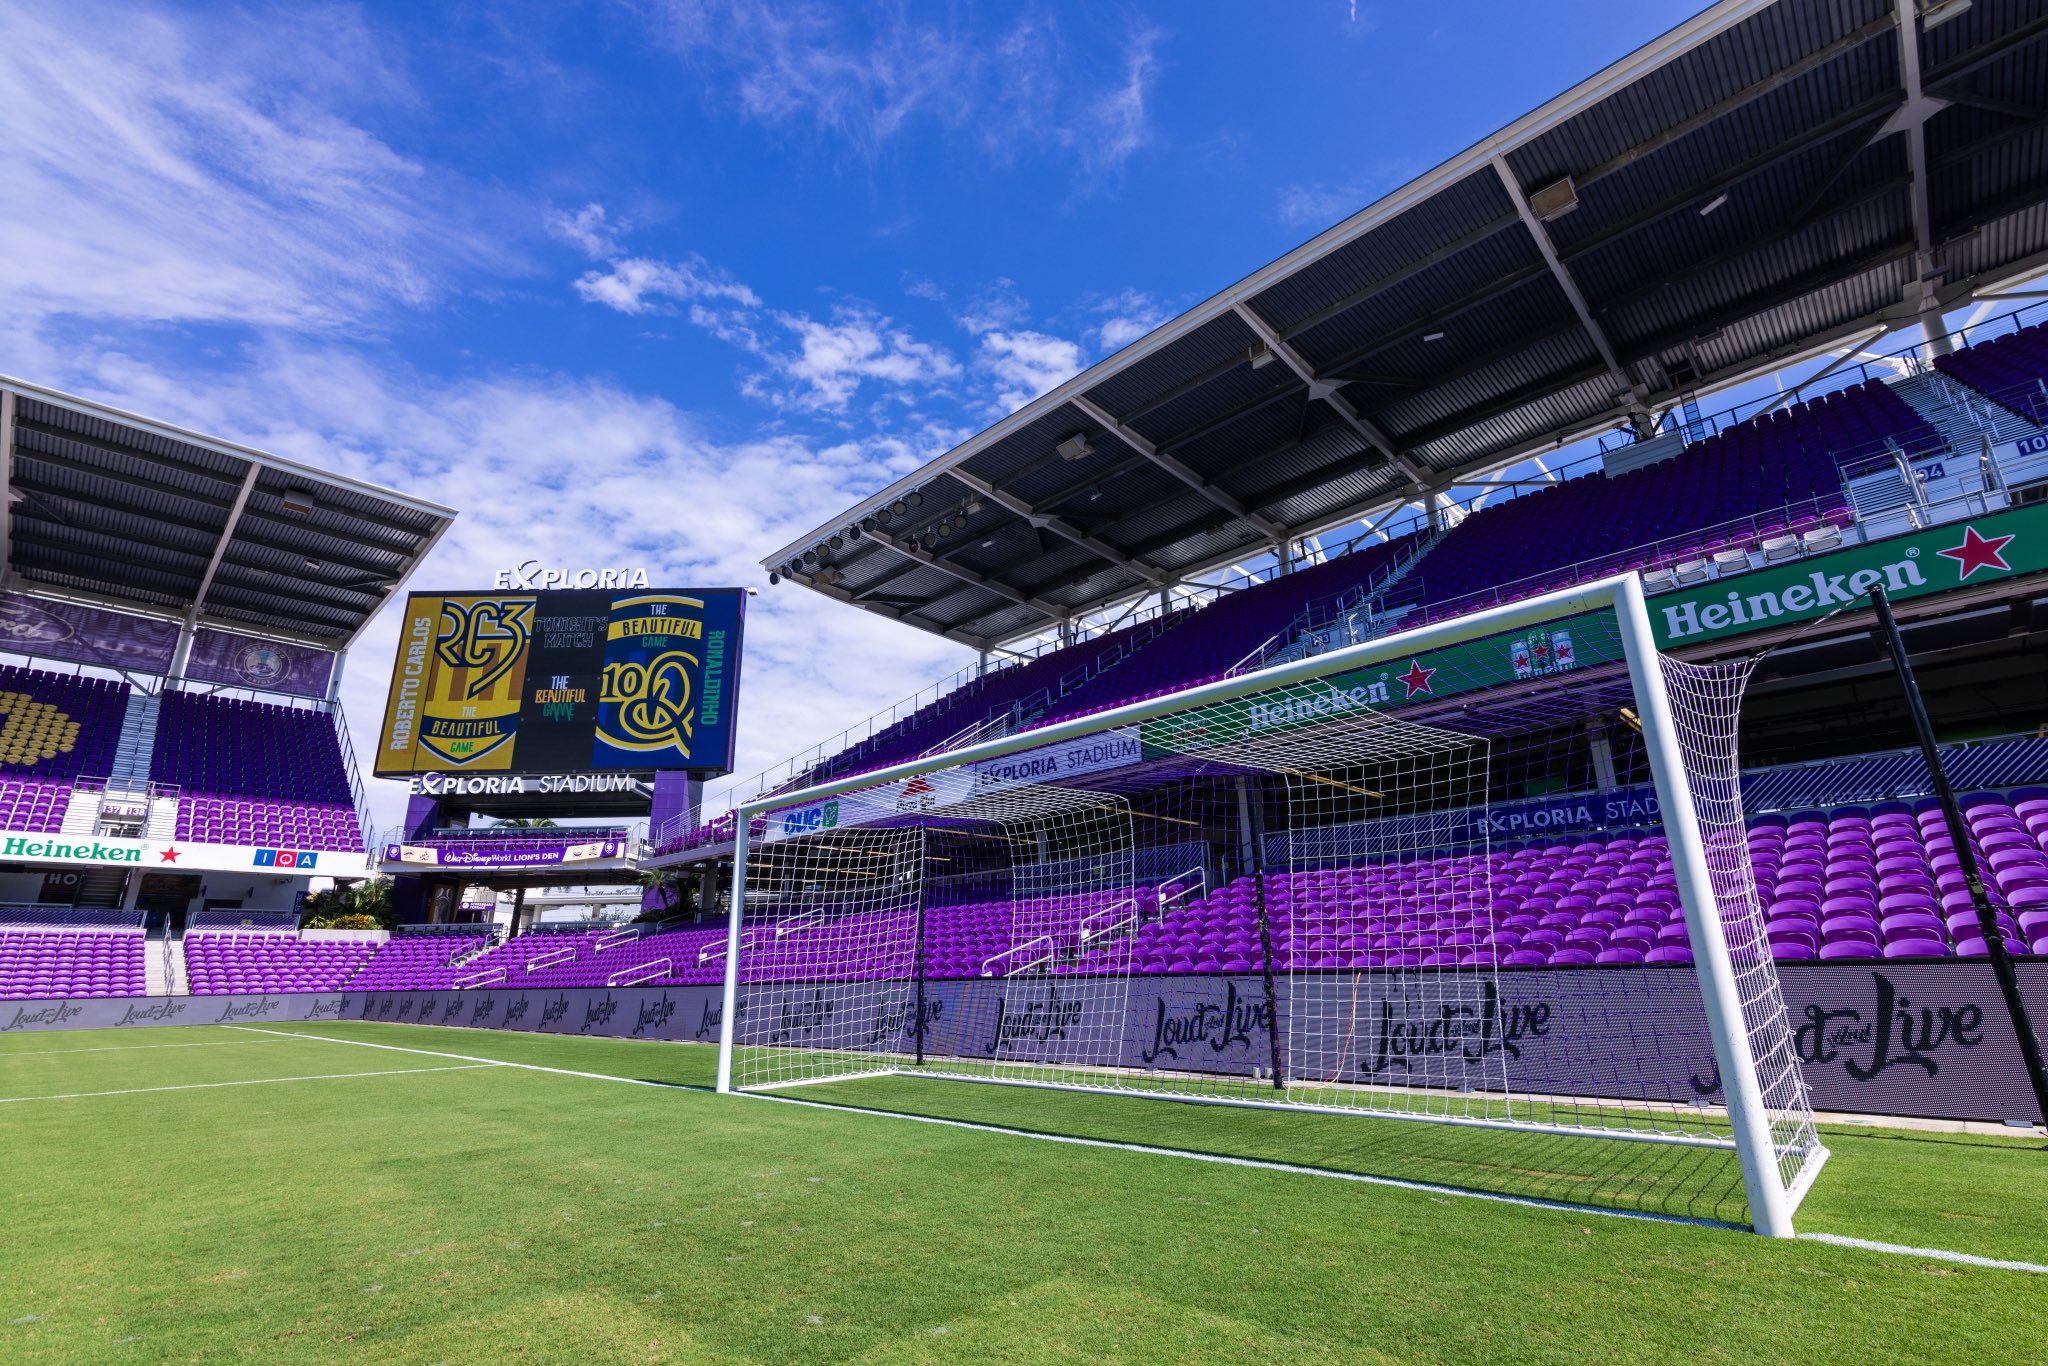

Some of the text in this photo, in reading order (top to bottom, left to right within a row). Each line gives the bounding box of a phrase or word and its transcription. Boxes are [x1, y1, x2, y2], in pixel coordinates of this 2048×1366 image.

[2020, 437, 2048, 453] 10
[493, 560, 650, 590] EXPLORIA
[651, 604, 667, 615] THE
[622, 618, 696, 637] BEAUTIFUL
[642, 636, 668, 648] GAME
[390, 617, 432, 750] ROBERTO CARLOS
[552, 676, 569, 689] THE
[701, 630, 726, 725] RONALDINHO
[535, 689, 585, 703] BEAUTIFUL
[462, 707, 477, 717] THE
[431, 720, 500, 737] BEAUTIFUL
[450, 741, 474, 753] GAME
[1067, 739, 1138, 769] STADIUM
[408, 772, 631, 795] EXPLORIA STADIUM
[102, 805, 146, 816] 137 138
[1477, 797, 1662, 835] EXPLORIA STAD
[513, 853, 540, 862] LION'S
[541, 852, 560, 861] DEN
